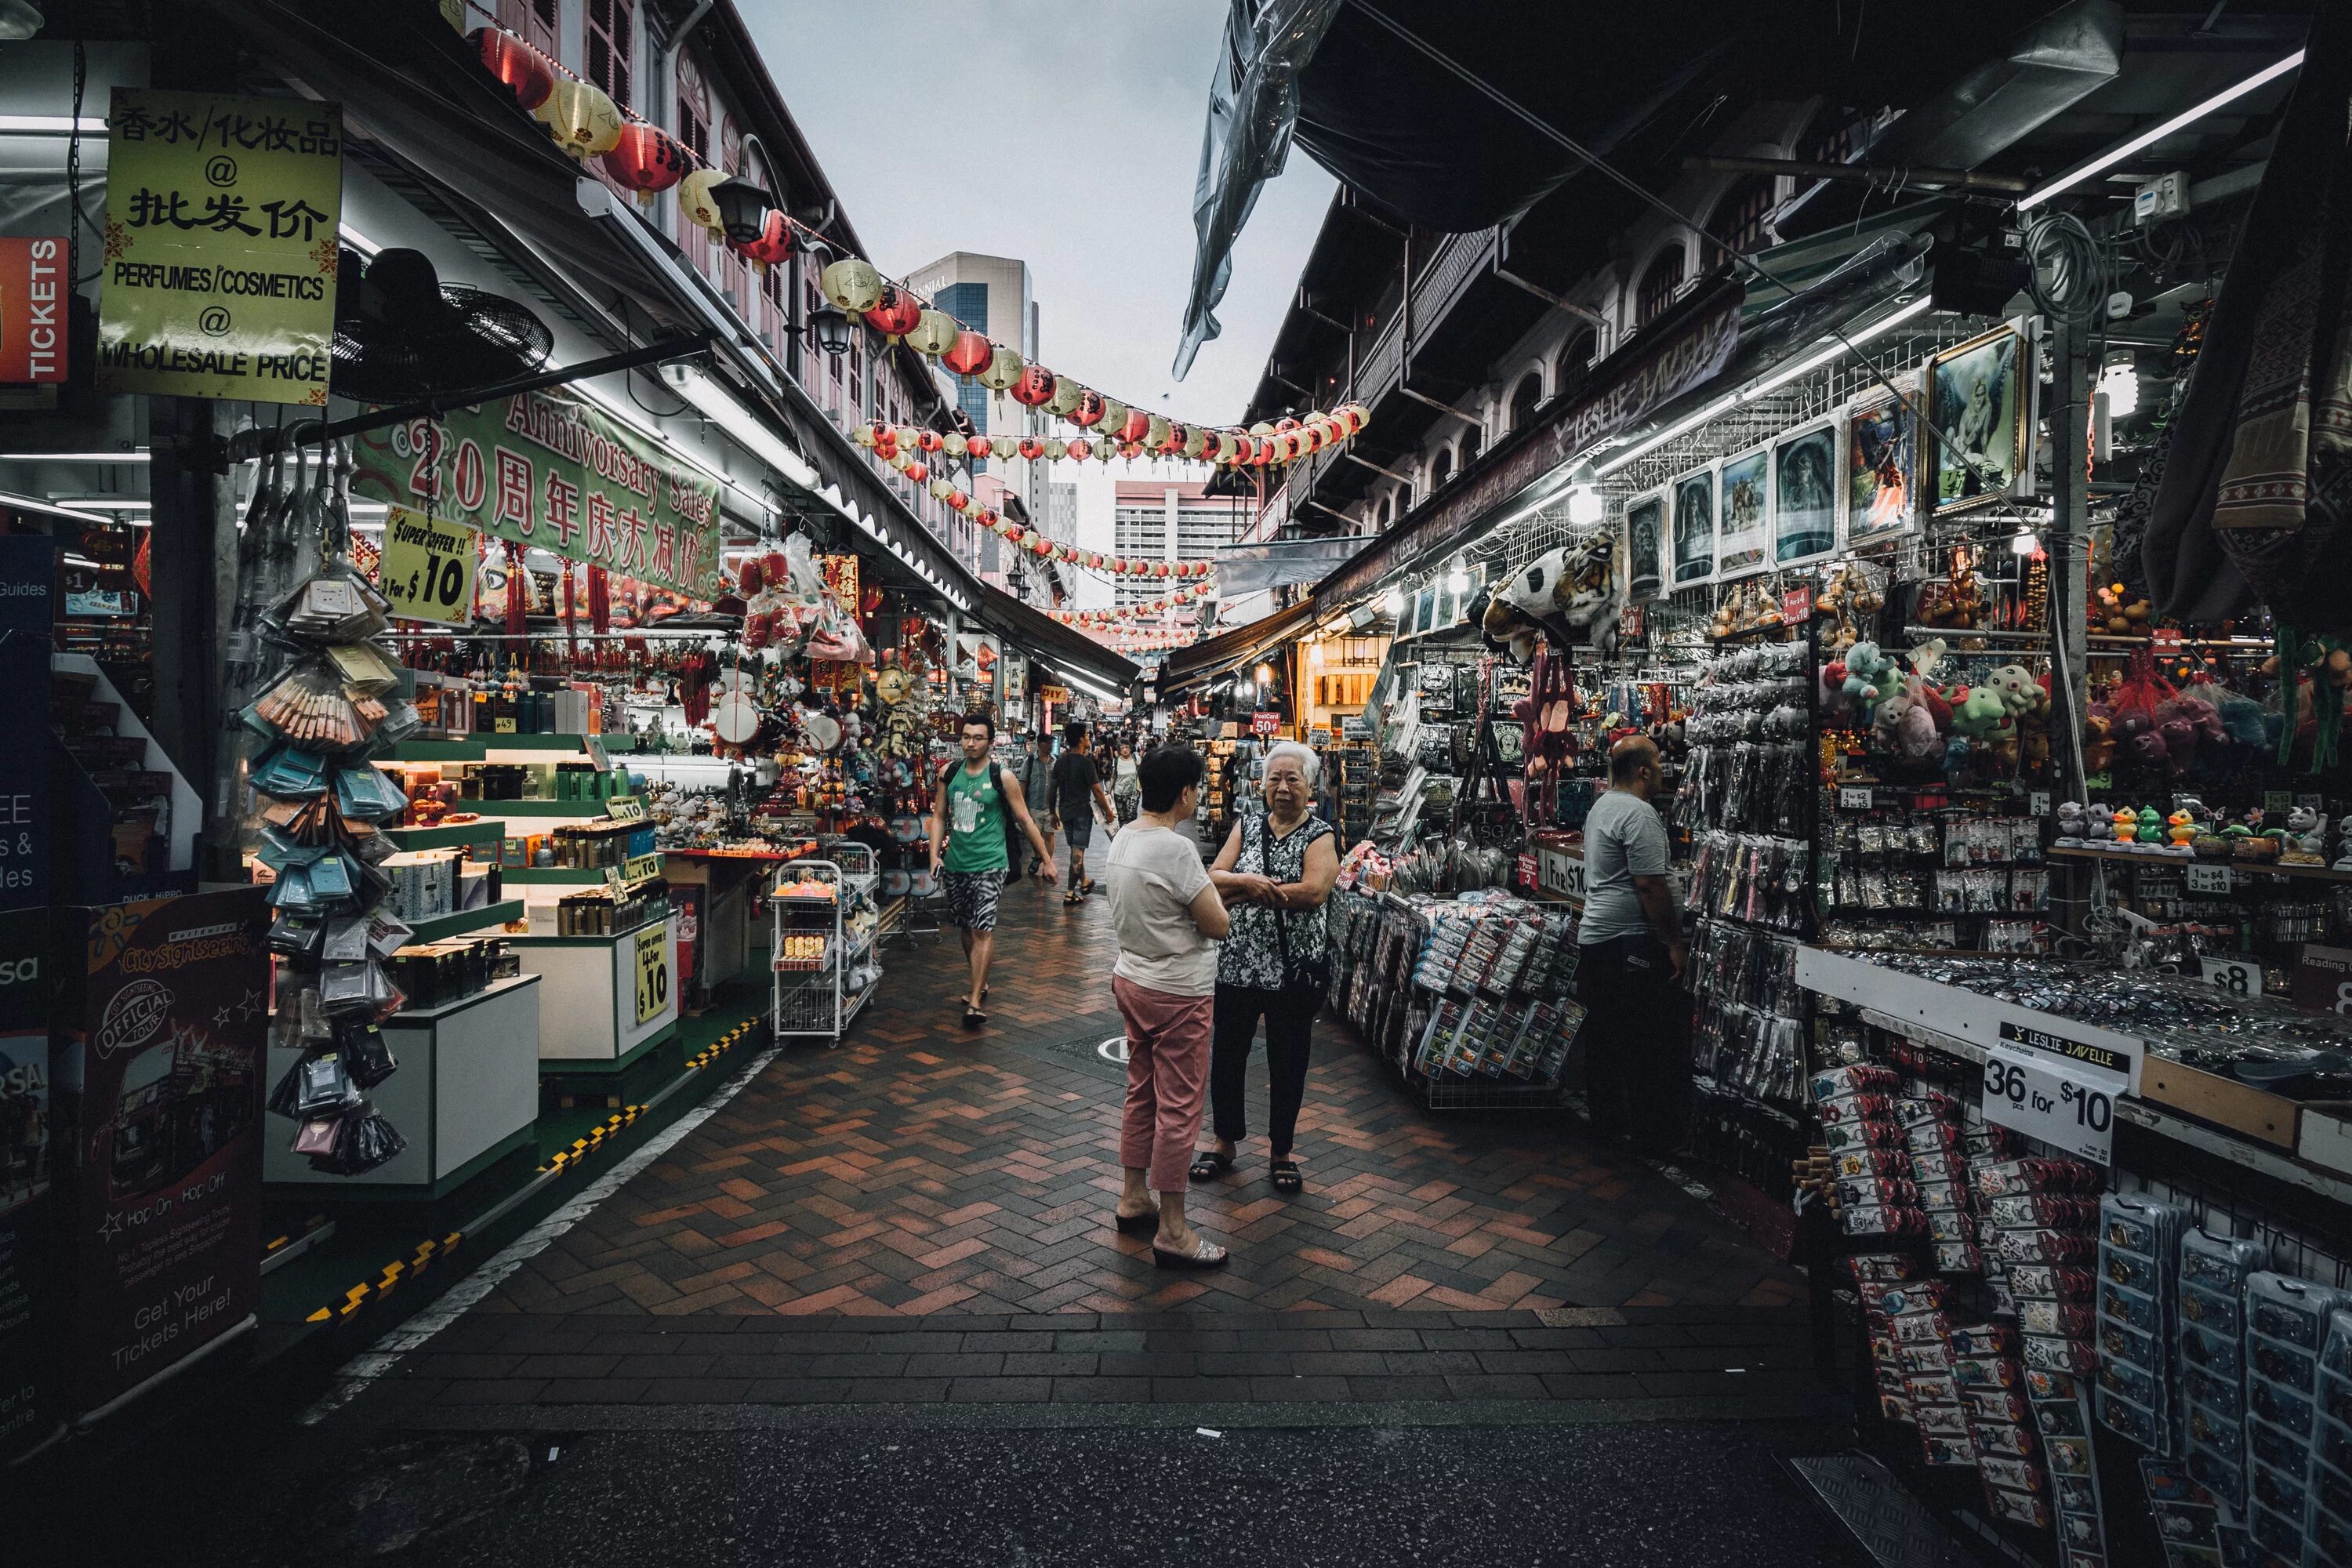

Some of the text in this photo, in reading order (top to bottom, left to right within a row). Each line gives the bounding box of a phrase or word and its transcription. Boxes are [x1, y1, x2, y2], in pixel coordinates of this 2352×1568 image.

[113, 105, 338, 156] 香水/化妆品
[205, 155, 238, 187] @
[126, 187, 328, 241] 批发价
[114, 261, 324, 301] PERFUMES/COSMETICS
[30, 239, 56, 379] TICKETS
[199, 306, 231, 337] @
[101, 342, 326, 383] WHOLESALE PRICE
[506, 393, 713, 528] Annivorsary Sales
[0, 582, 46, 597] Guides
[65, 572, 84, 589] $1
[389, 579, 405, 597] For
[1042, 688, 1062, 699] DIY
[17, 832, 32, 855] &
[1480, 826, 1504, 839] SG
[2192, 880, 2198, 890] 3
[2210, 881, 2227, 891] $10
[2211, 870, 2223, 880] $4
[2302, 955, 2345, 972] Reading
[102, 993, 172, 1048] OFFICIAL
[132, 1014, 162, 1040] TOUR
[2028, 1031, 2114, 1067] LESLIE JAVELLE
[1984, 1058, 2027, 1103] 36
[2013, 1102, 2024, 1112] pcs
[2031, 1080, 2111, 1133] for $10
[156, 1197, 172, 1216] On
[208, 1171, 226, 1192] Off
[118, 1253, 153, 1276] Probably
[125, 1261, 164, 1290] passenger
[134, 1275, 215, 1330] Get Your
[111, 1287, 231, 1371] Tickets Here!
[0, 1385, 35, 1414] er to
